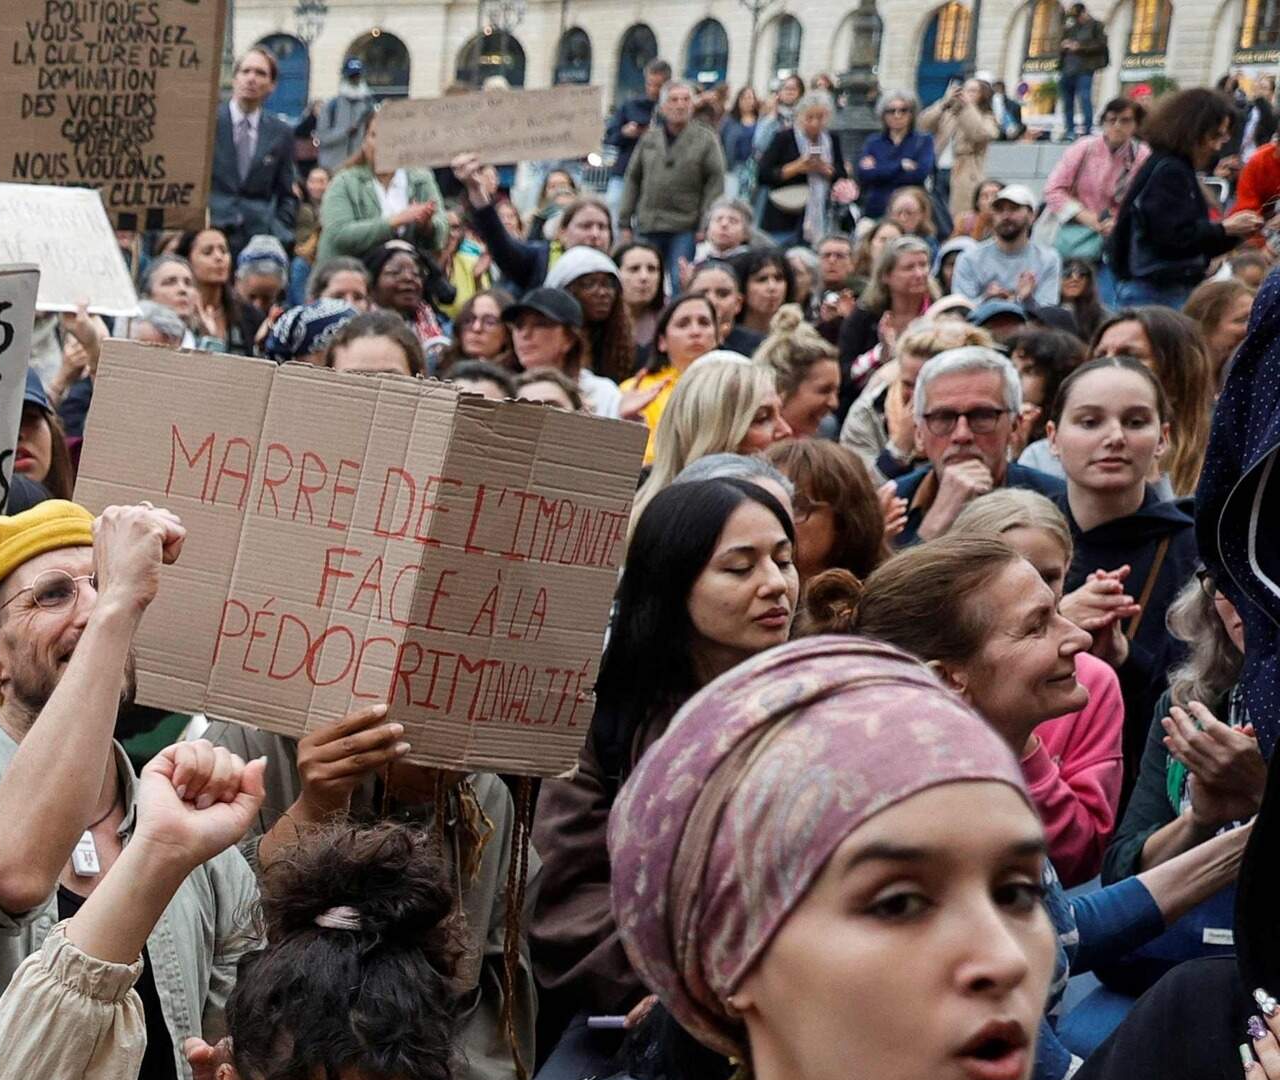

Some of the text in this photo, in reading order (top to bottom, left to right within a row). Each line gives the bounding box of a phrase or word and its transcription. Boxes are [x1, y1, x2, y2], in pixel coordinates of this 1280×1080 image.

[45, 0, 160, 26] POLITIQUES
[26, 21, 194, 46] VOUS INCARNEZ
[13, 41, 201, 70] LA CULTURE DE LA
[37, 66, 157, 91] DOMINATION
[21, 93, 158, 119] DES VIOLEURS
[12, 152, 166, 179] NOUS VOULONS
[109, 184, 195, 206] CULTURE
[165, 423, 361, 530] MARRE
[373, 466, 463, 548] DE
[317, 546, 548, 641] FACE À LA
[211, 597, 596, 727] PÉDOCRIMINALITÉ
